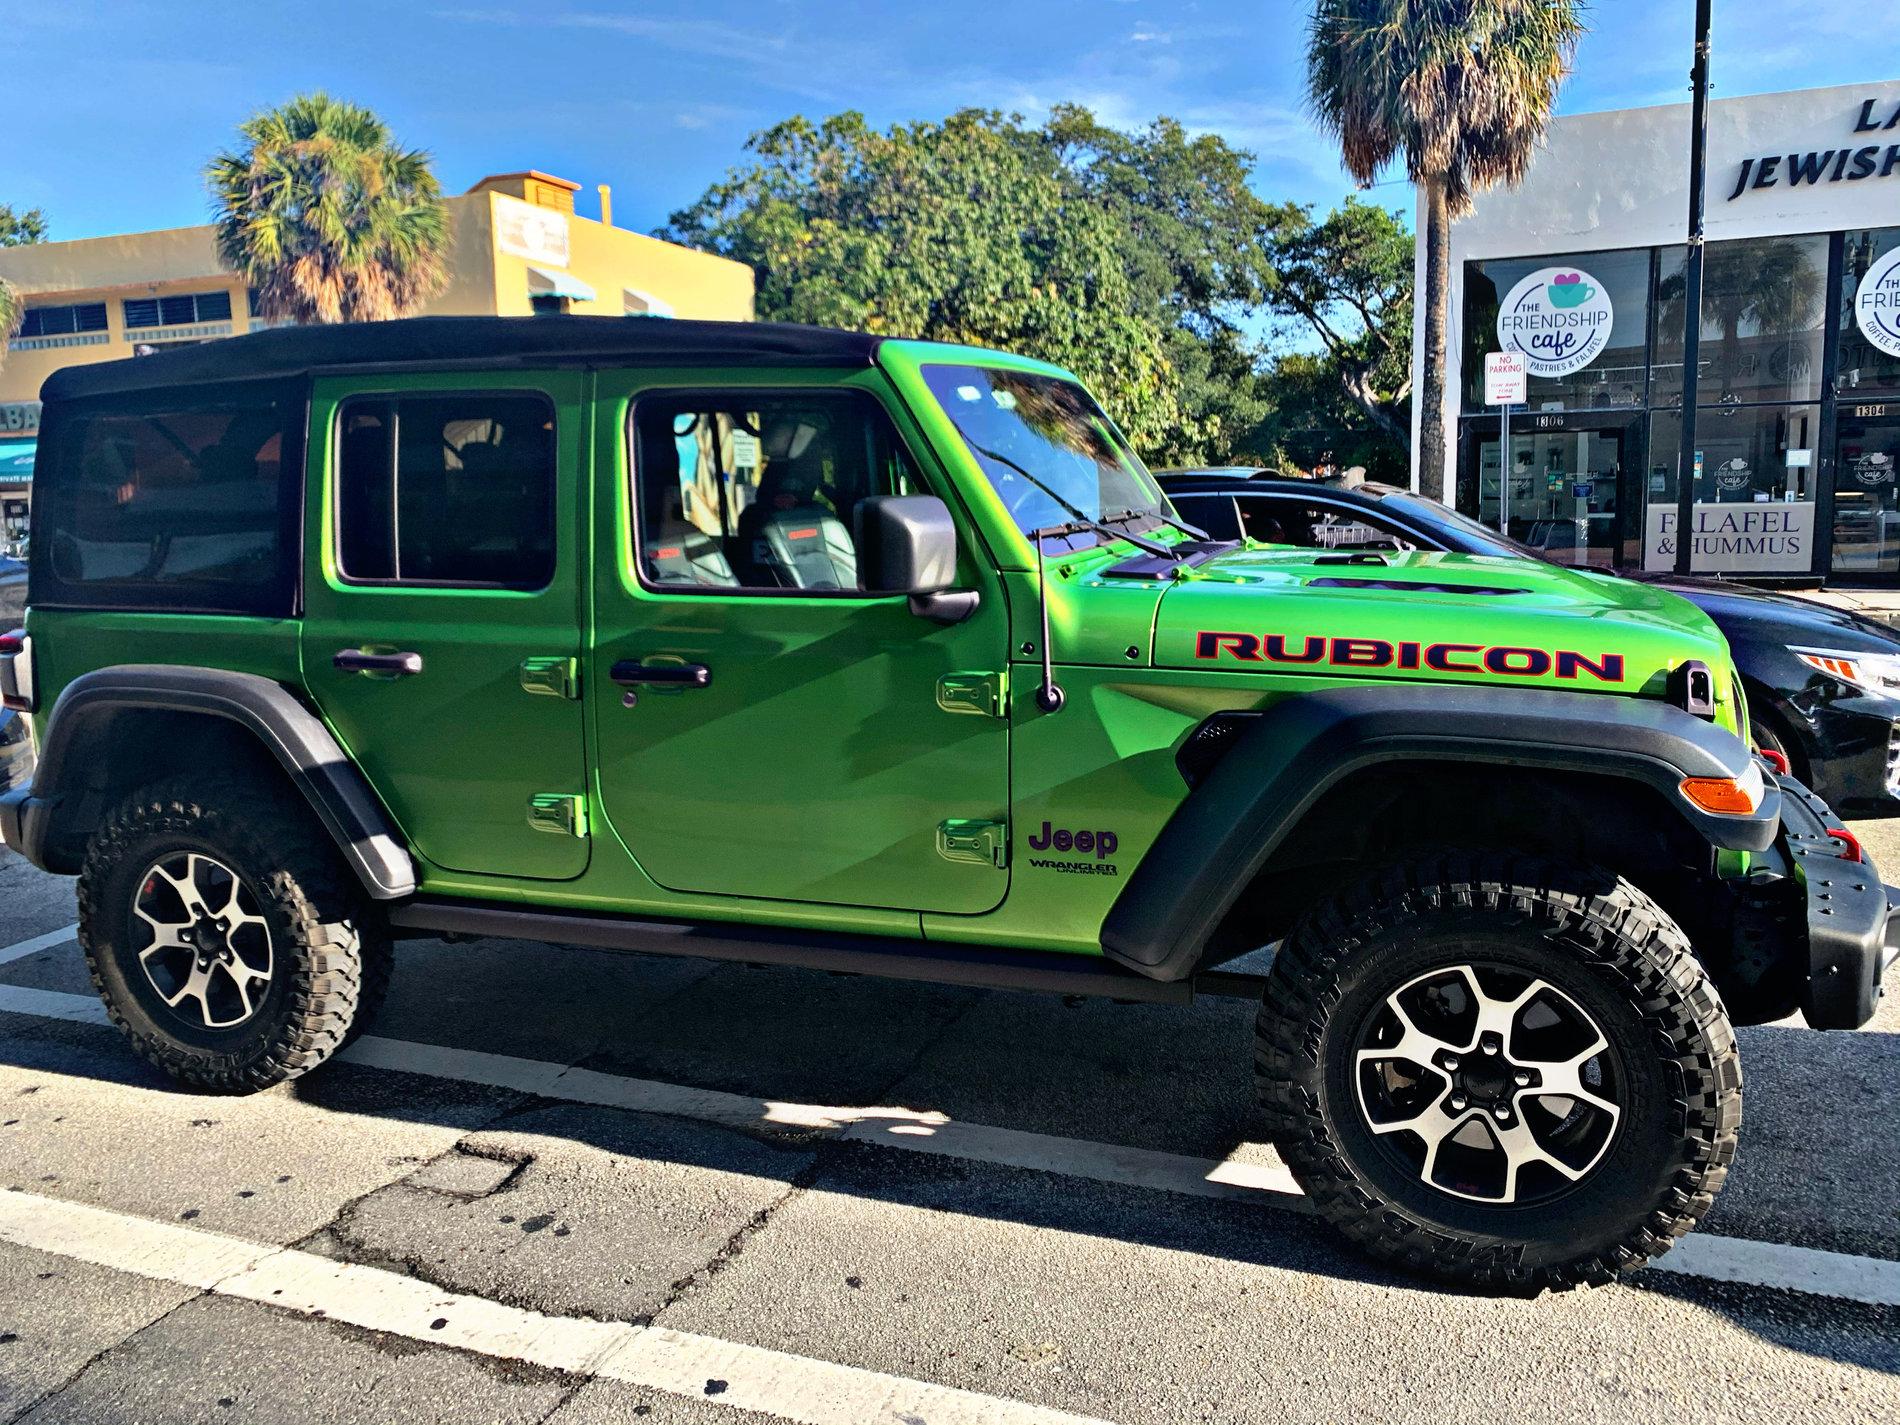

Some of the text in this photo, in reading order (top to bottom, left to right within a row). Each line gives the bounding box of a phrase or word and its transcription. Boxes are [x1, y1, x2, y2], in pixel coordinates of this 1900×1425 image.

[1522, 303, 1540, 312] THE
[1502, 311, 1608, 331] FRIENDSHIP
[1532, 331, 1576, 356] cafe
[1500, 356, 1511, 364] NO
[1530, 361, 1566, 372] PASTRIES
[1576, 337, 1602, 364] FALAFEL
[1489, 364, 1521, 373] PARKING
[1859, 406, 1884, 415] 1304
[1536, 416, 1564, 427] 1306
[1724, 475, 1741, 486] cafe
[1657, 537, 1675, 554] &
[1195, 630, 1625, 682] RUBICON
[1028, 821, 1118, 859] Jeep
[1029, 858, 1117, 872] WRANGLER
